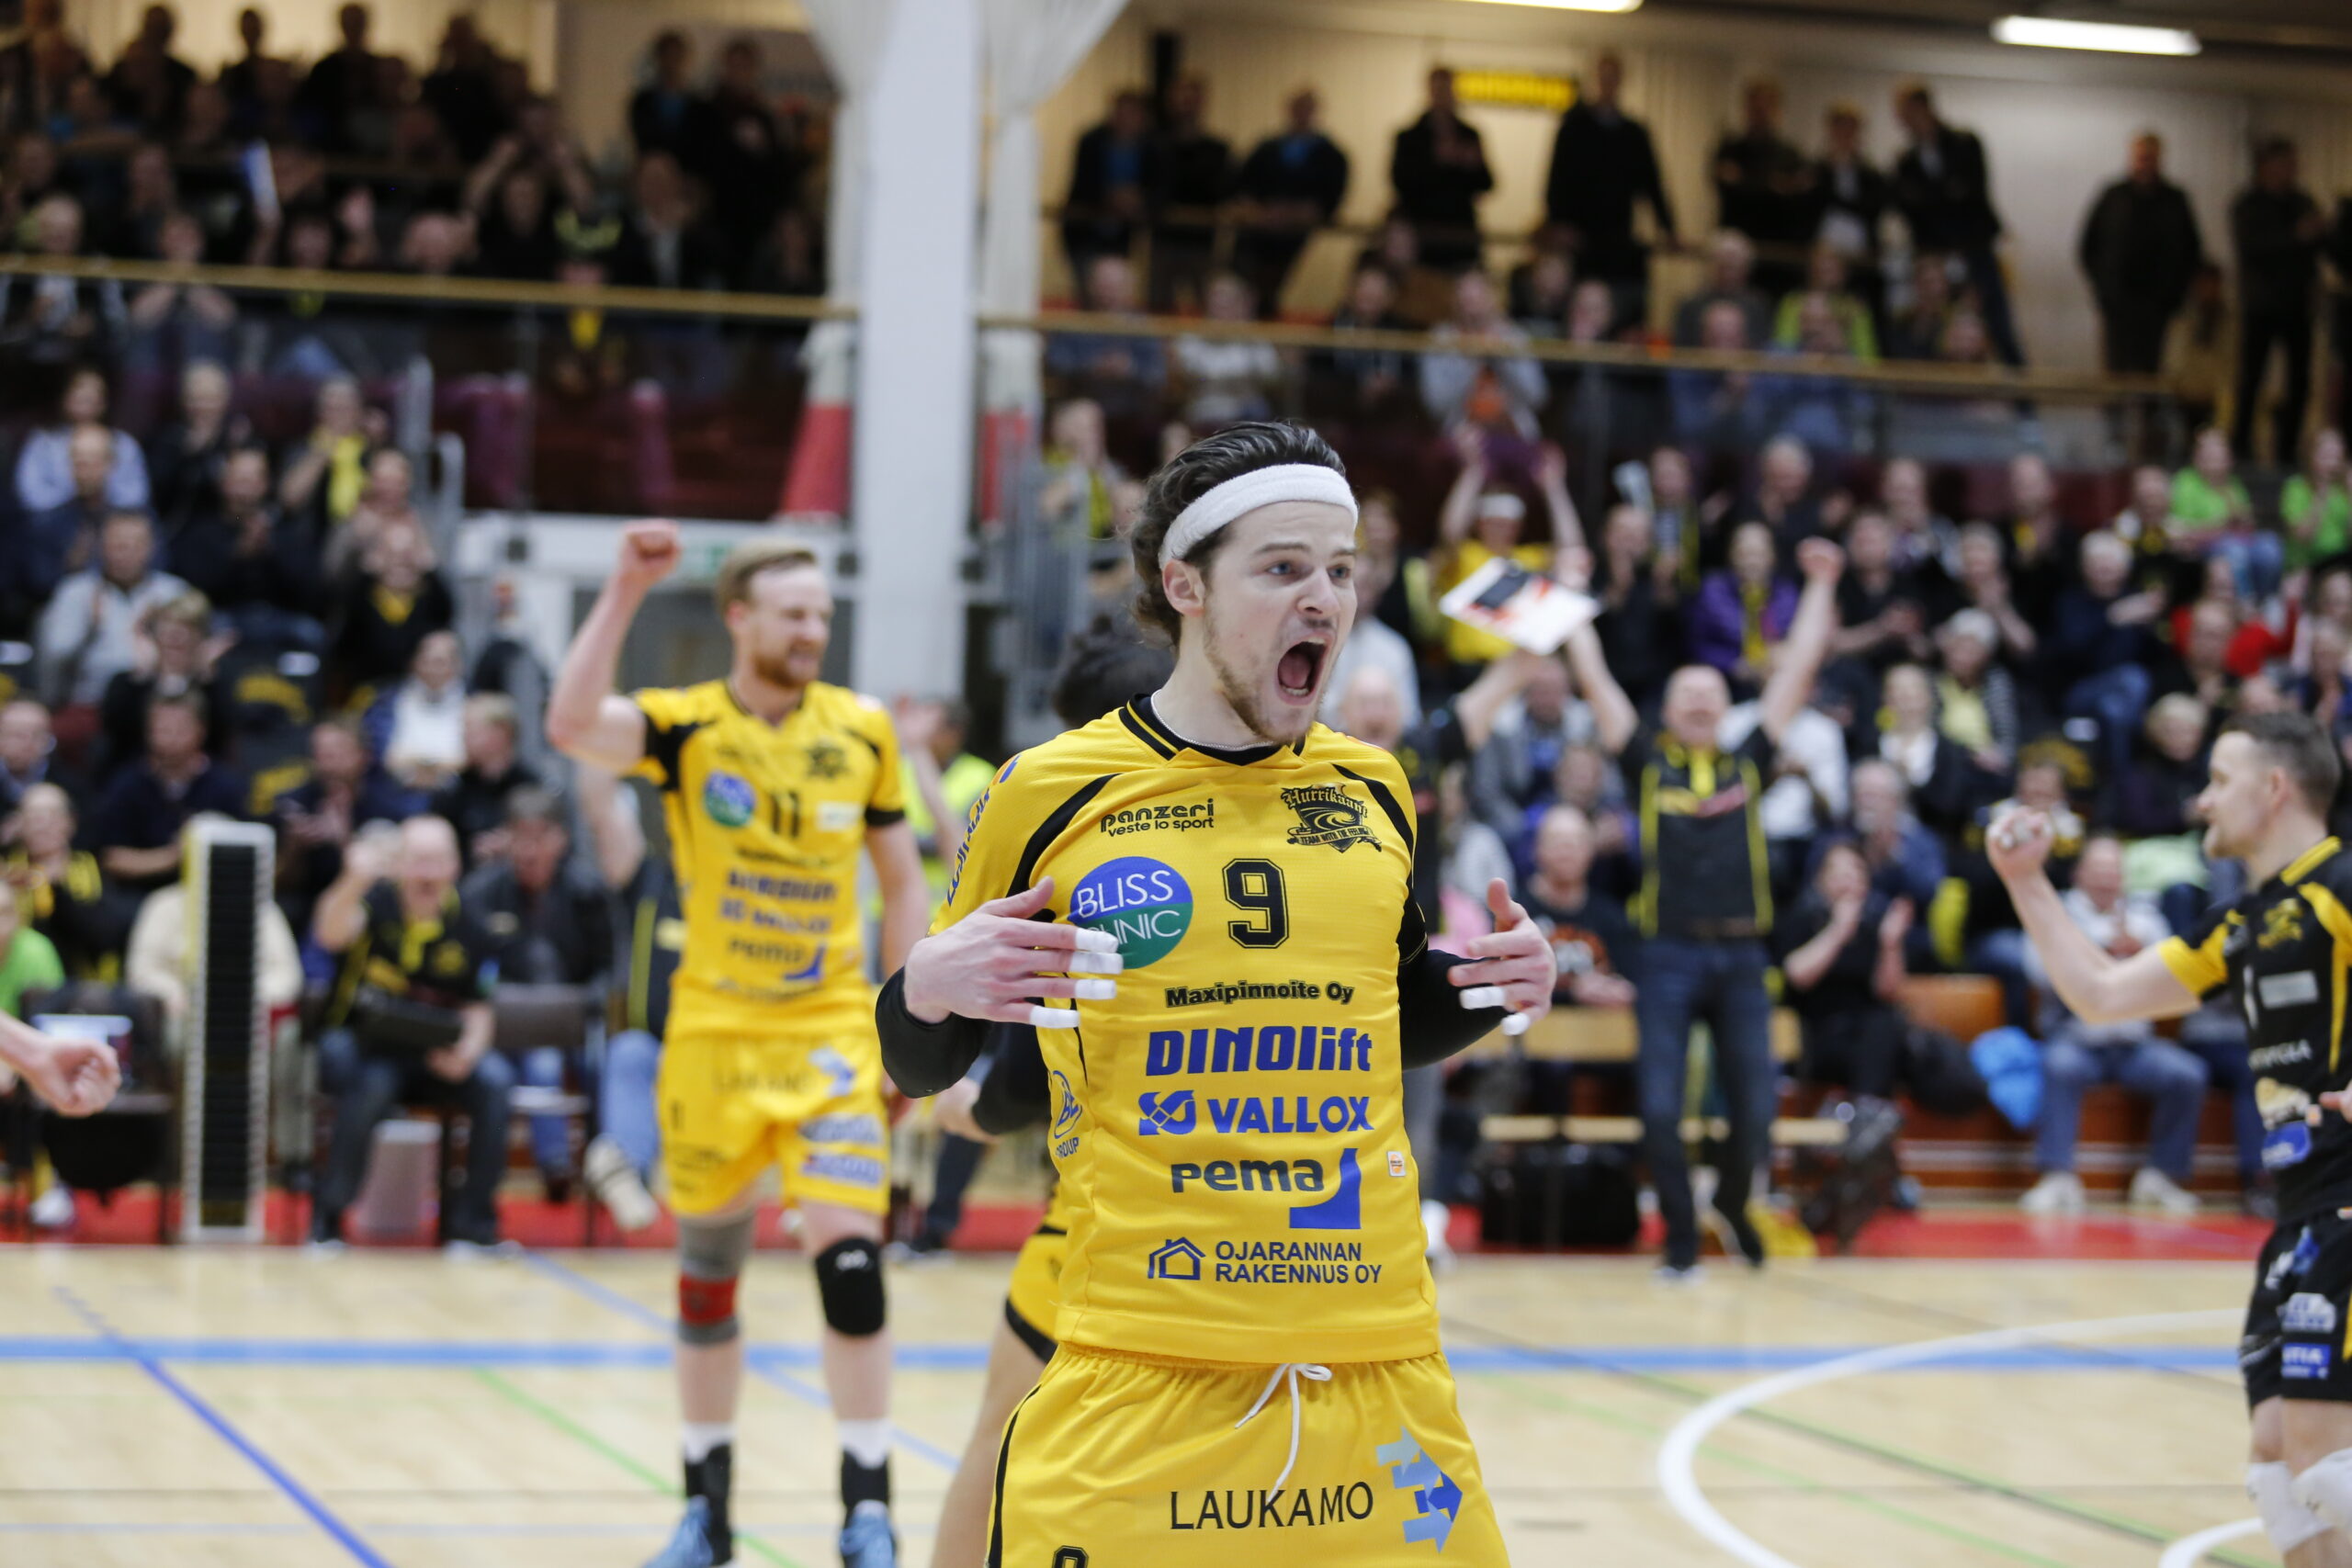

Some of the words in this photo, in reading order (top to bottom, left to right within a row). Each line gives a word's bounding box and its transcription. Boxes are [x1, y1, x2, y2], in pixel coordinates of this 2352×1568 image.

[1101, 798, 1214, 833] panzeri
[1108, 822, 1151, 837] veste
[1155, 820, 1170, 829] lo
[1172, 818, 1214, 831] sport
[1077, 870, 1173, 918] BLISS
[1222, 858, 1289, 949] 9
[1086, 909, 1182, 945] INIC
[1165, 981, 1319, 1009] Maxipinnoite
[1326, 982, 1354, 1004] Oy
[1145, 1025, 1373, 1077] DINOlift
[1207, 1096, 1374, 1134] VALLOX
[1170, 1158, 1325, 1193] pema
[1215, 1240, 1362, 1262] OJARANNAN
[1215, 1263, 1350, 1284] RAKENNUS
[1354, 1264, 1382, 1284] OY
[1170, 1481, 1374, 1529] LAUKAMO
